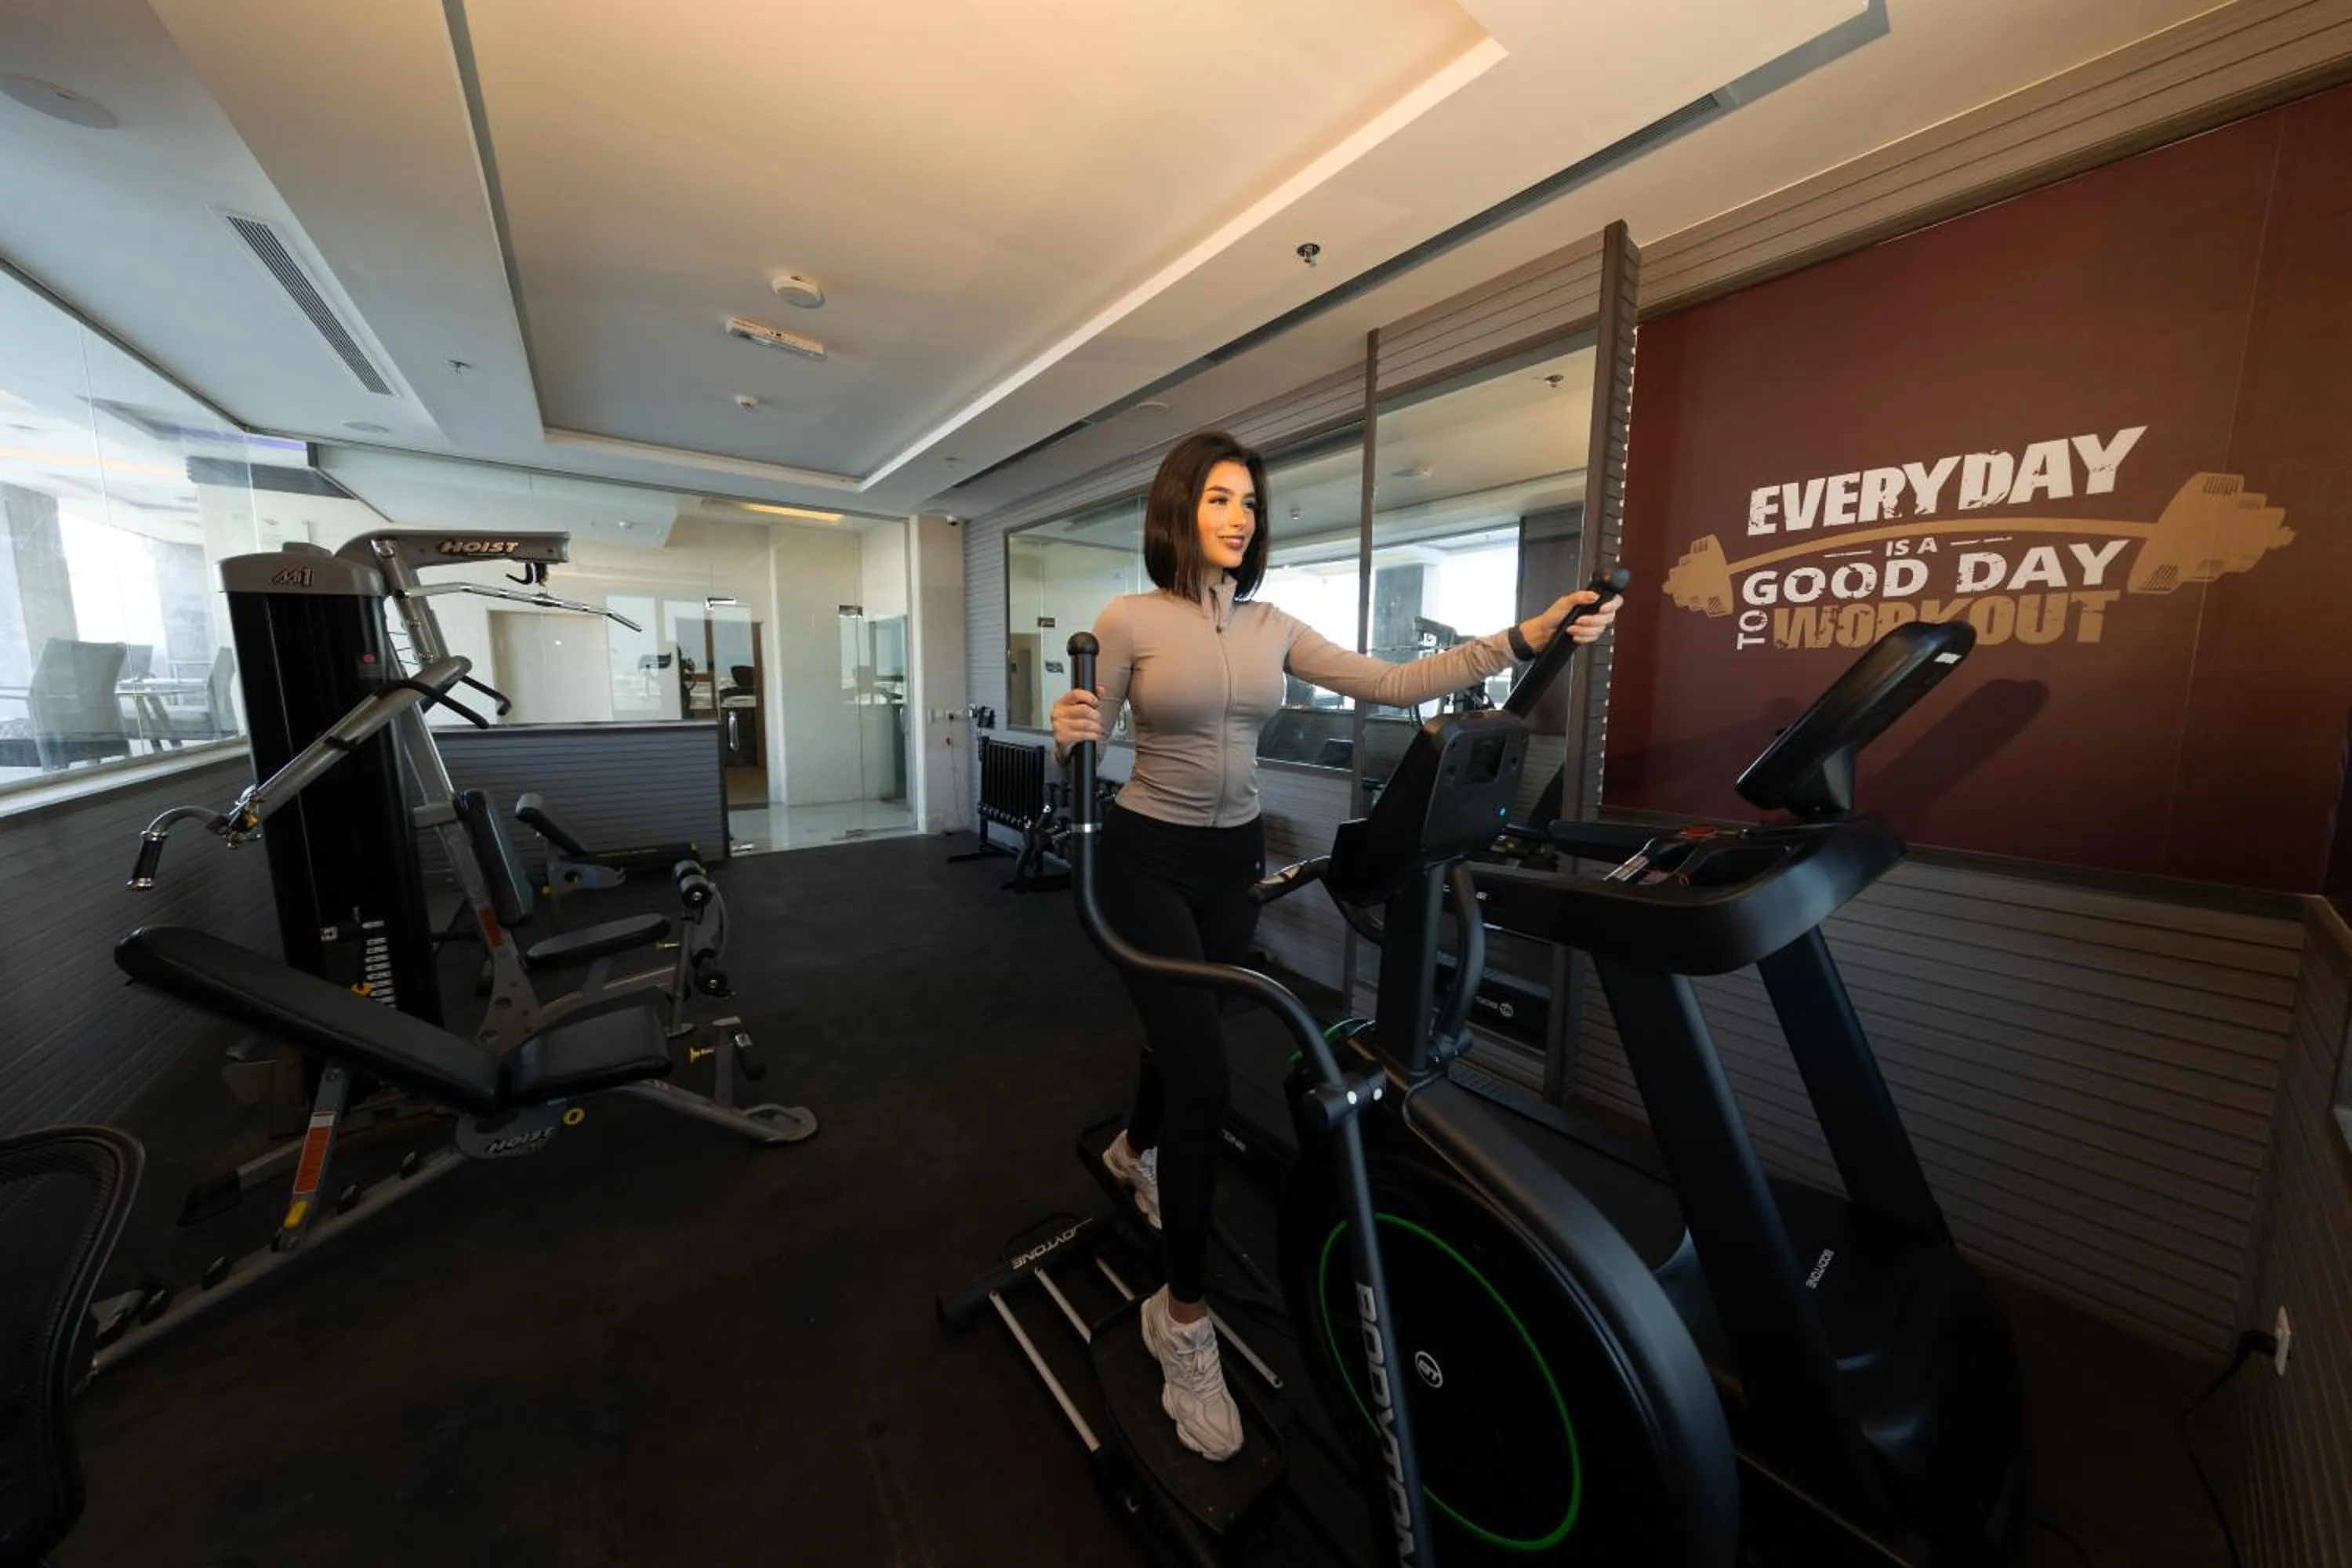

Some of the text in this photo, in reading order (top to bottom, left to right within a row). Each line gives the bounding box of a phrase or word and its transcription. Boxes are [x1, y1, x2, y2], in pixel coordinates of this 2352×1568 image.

[1747, 426, 2147, 536] EVERYDAY
[440, 540, 518, 554] HOIST
[1885, 537, 1938, 557] IS A
[1742, 539, 2131, 606] GOOD DAY
[1737, 609, 1768, 650] TO
